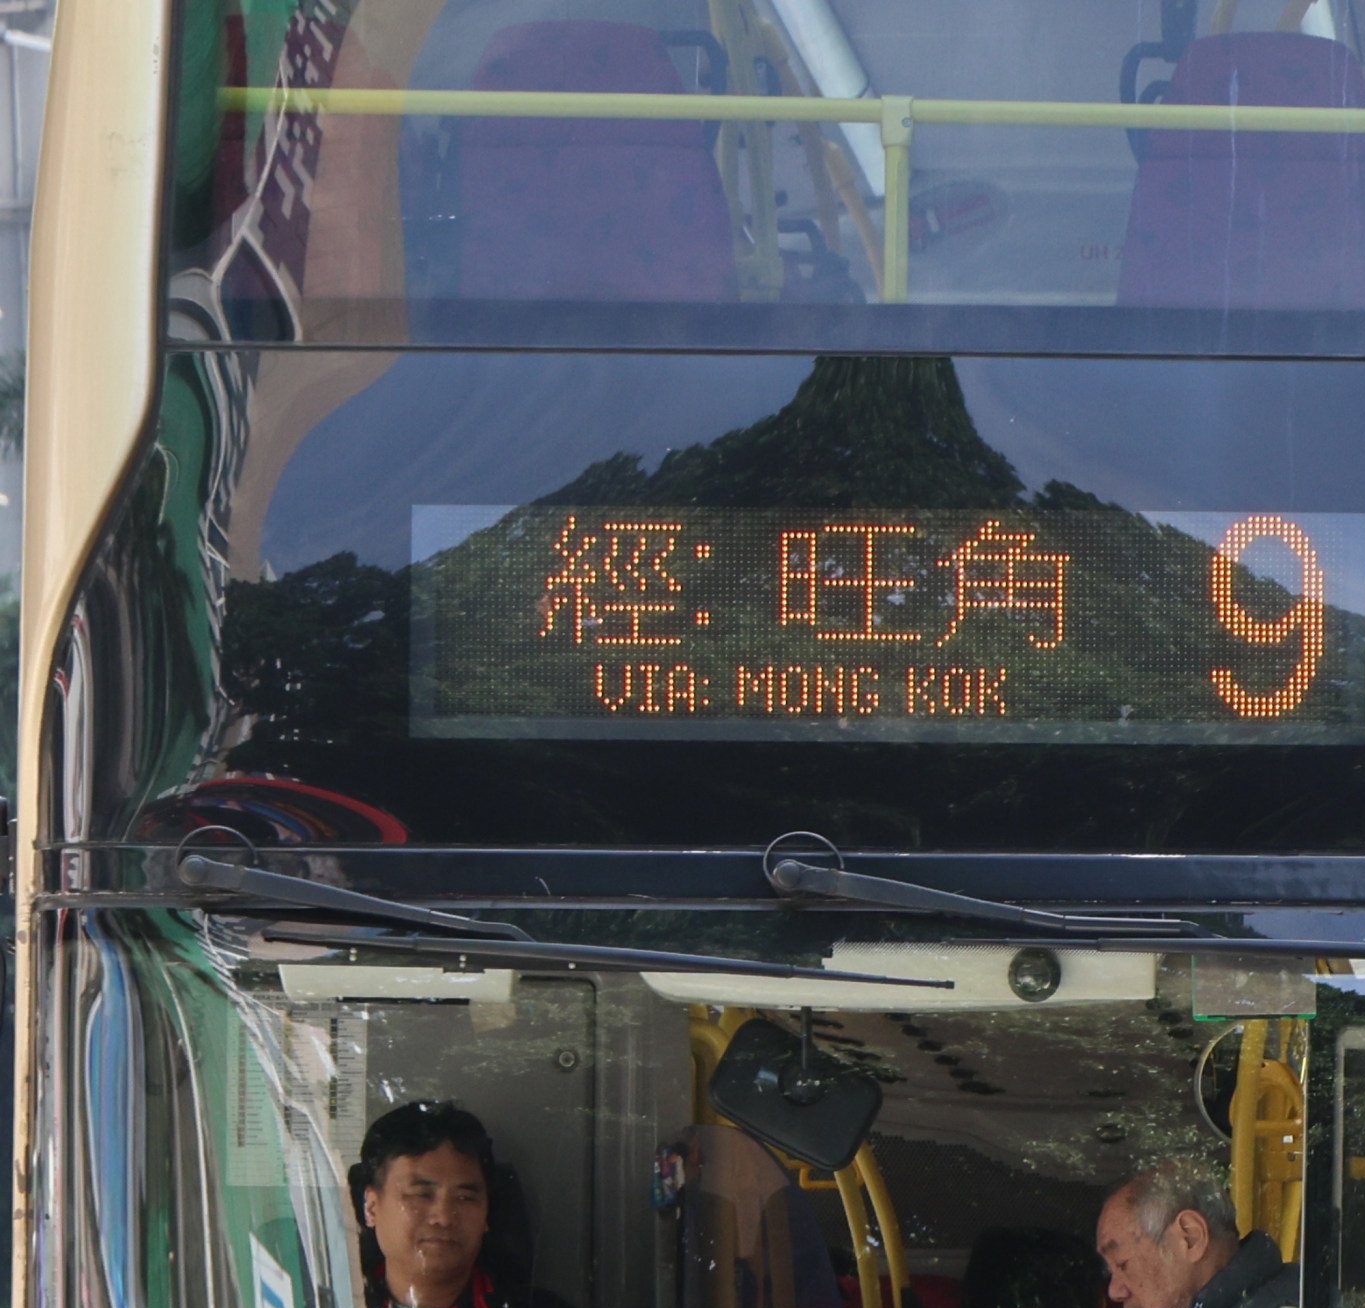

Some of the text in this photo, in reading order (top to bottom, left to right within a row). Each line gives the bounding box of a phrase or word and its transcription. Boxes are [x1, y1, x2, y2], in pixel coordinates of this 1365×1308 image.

[779, 521, 1070, 649] 旺角
[1209, 514, 1325, 718] 9
[595, 663, 1007, 715] VIA: MONG KOK
